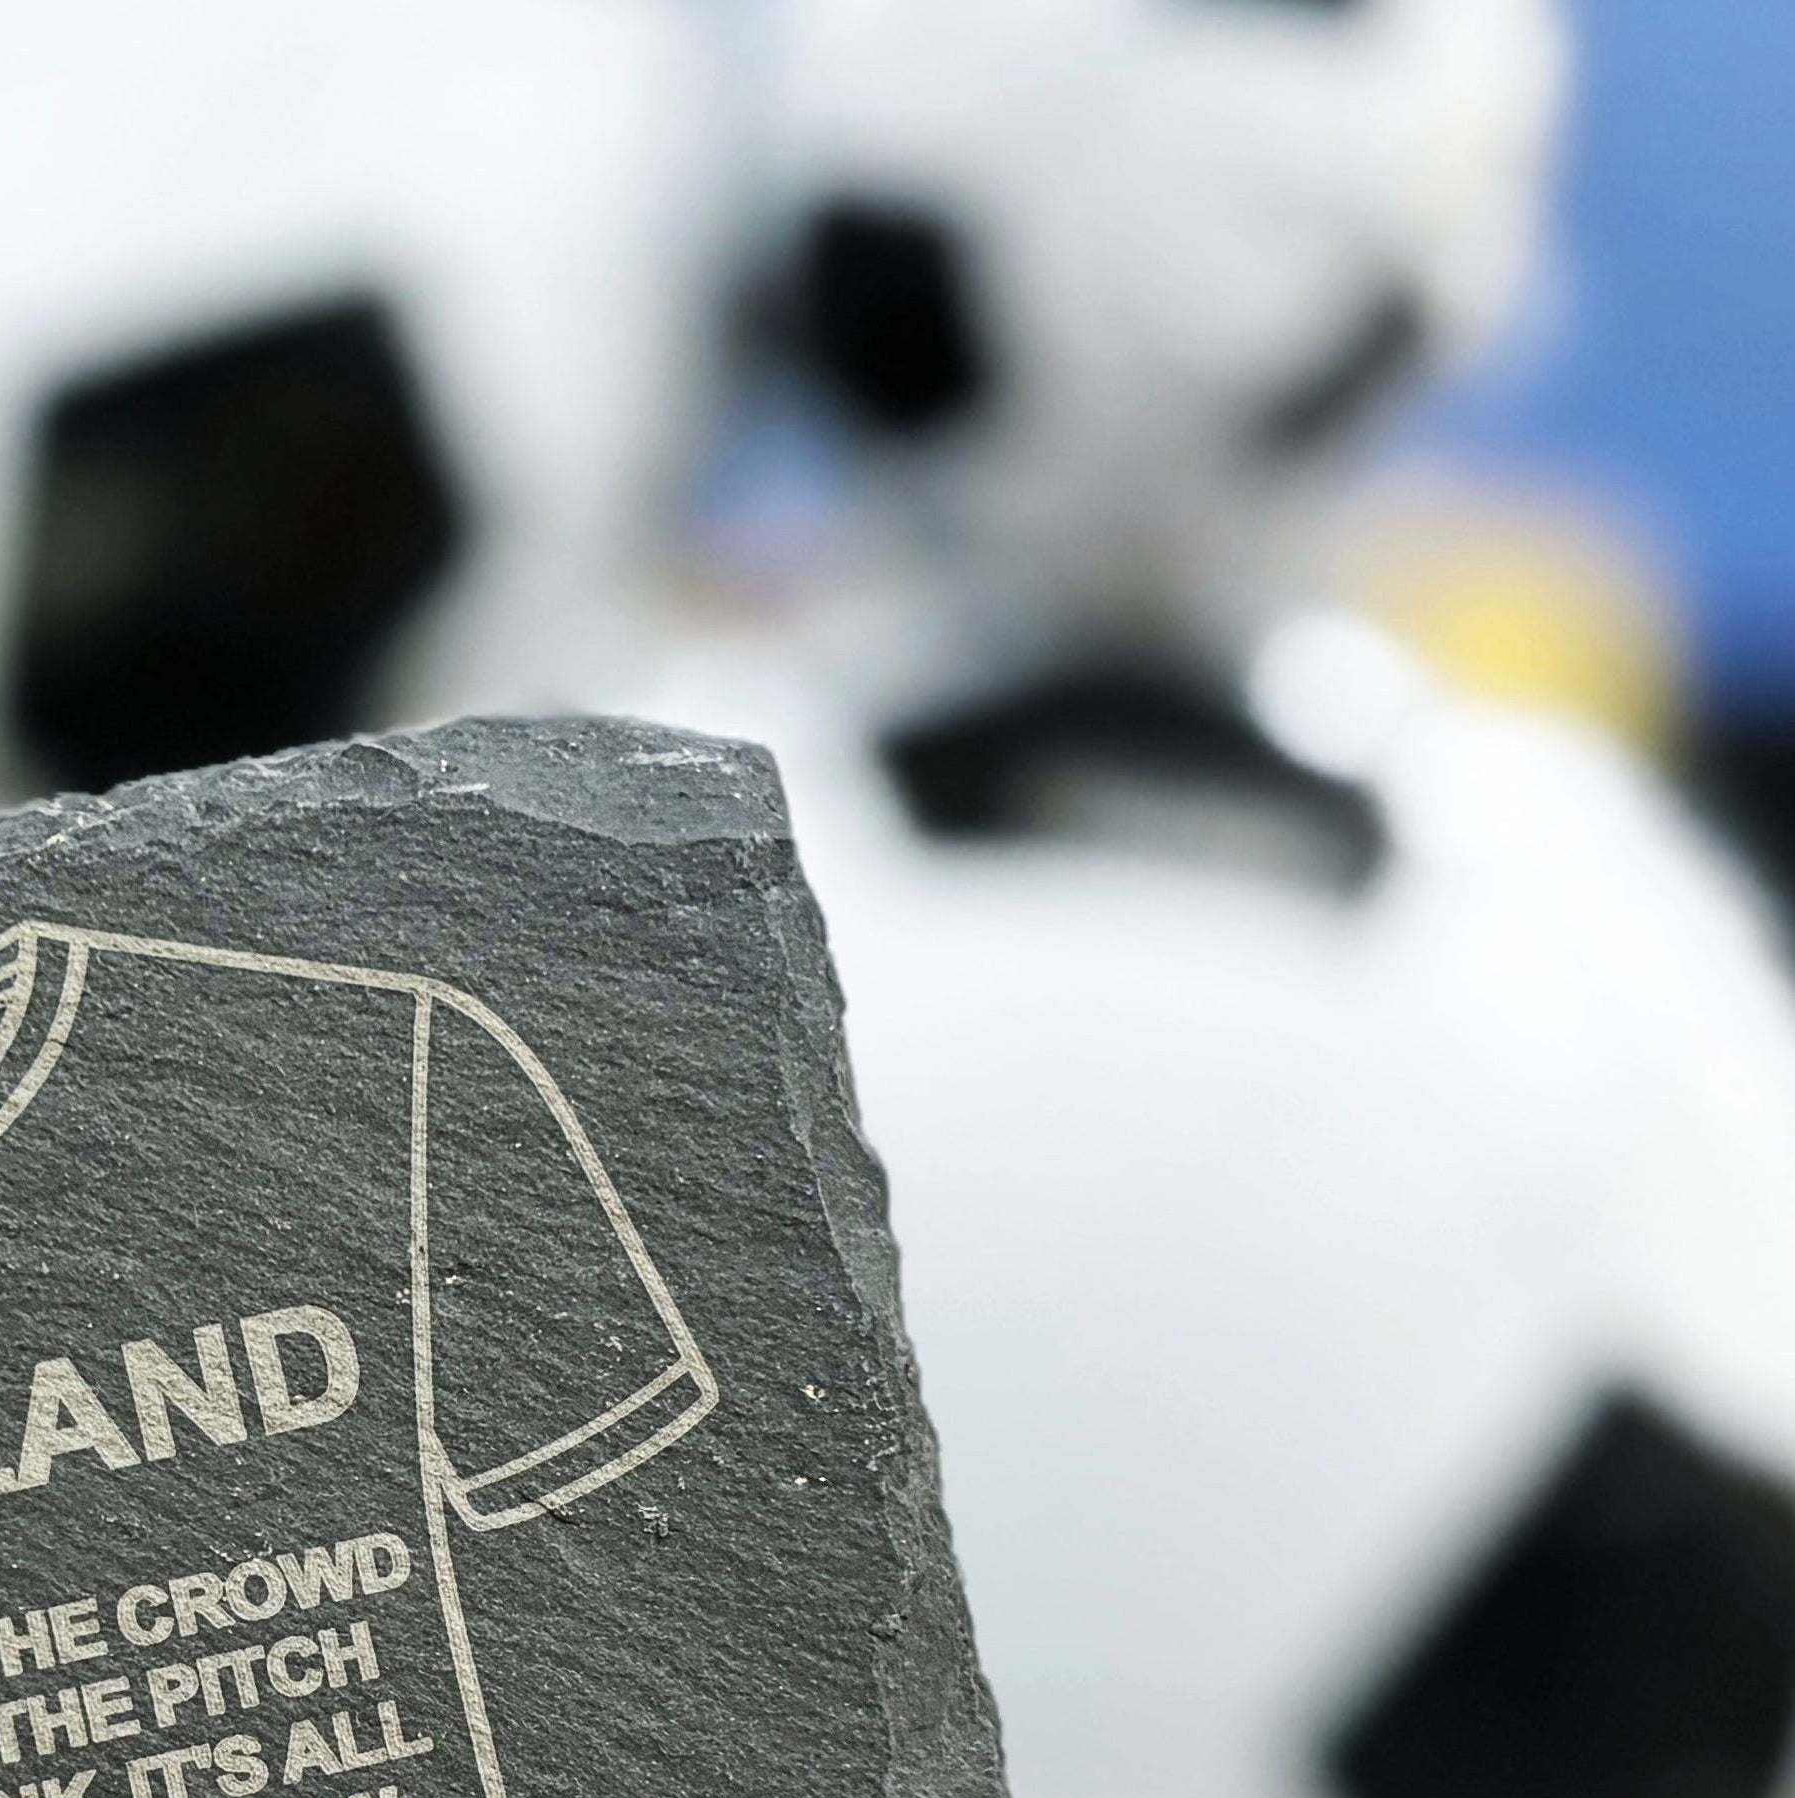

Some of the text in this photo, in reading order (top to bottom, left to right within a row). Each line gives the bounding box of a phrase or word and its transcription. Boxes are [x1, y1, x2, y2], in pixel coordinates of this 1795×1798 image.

[117, 1534, 413, 1647] CROWD
[148, 1621, 380, 1729] PITCH
[282, 1702, 435, 1783] ALL
